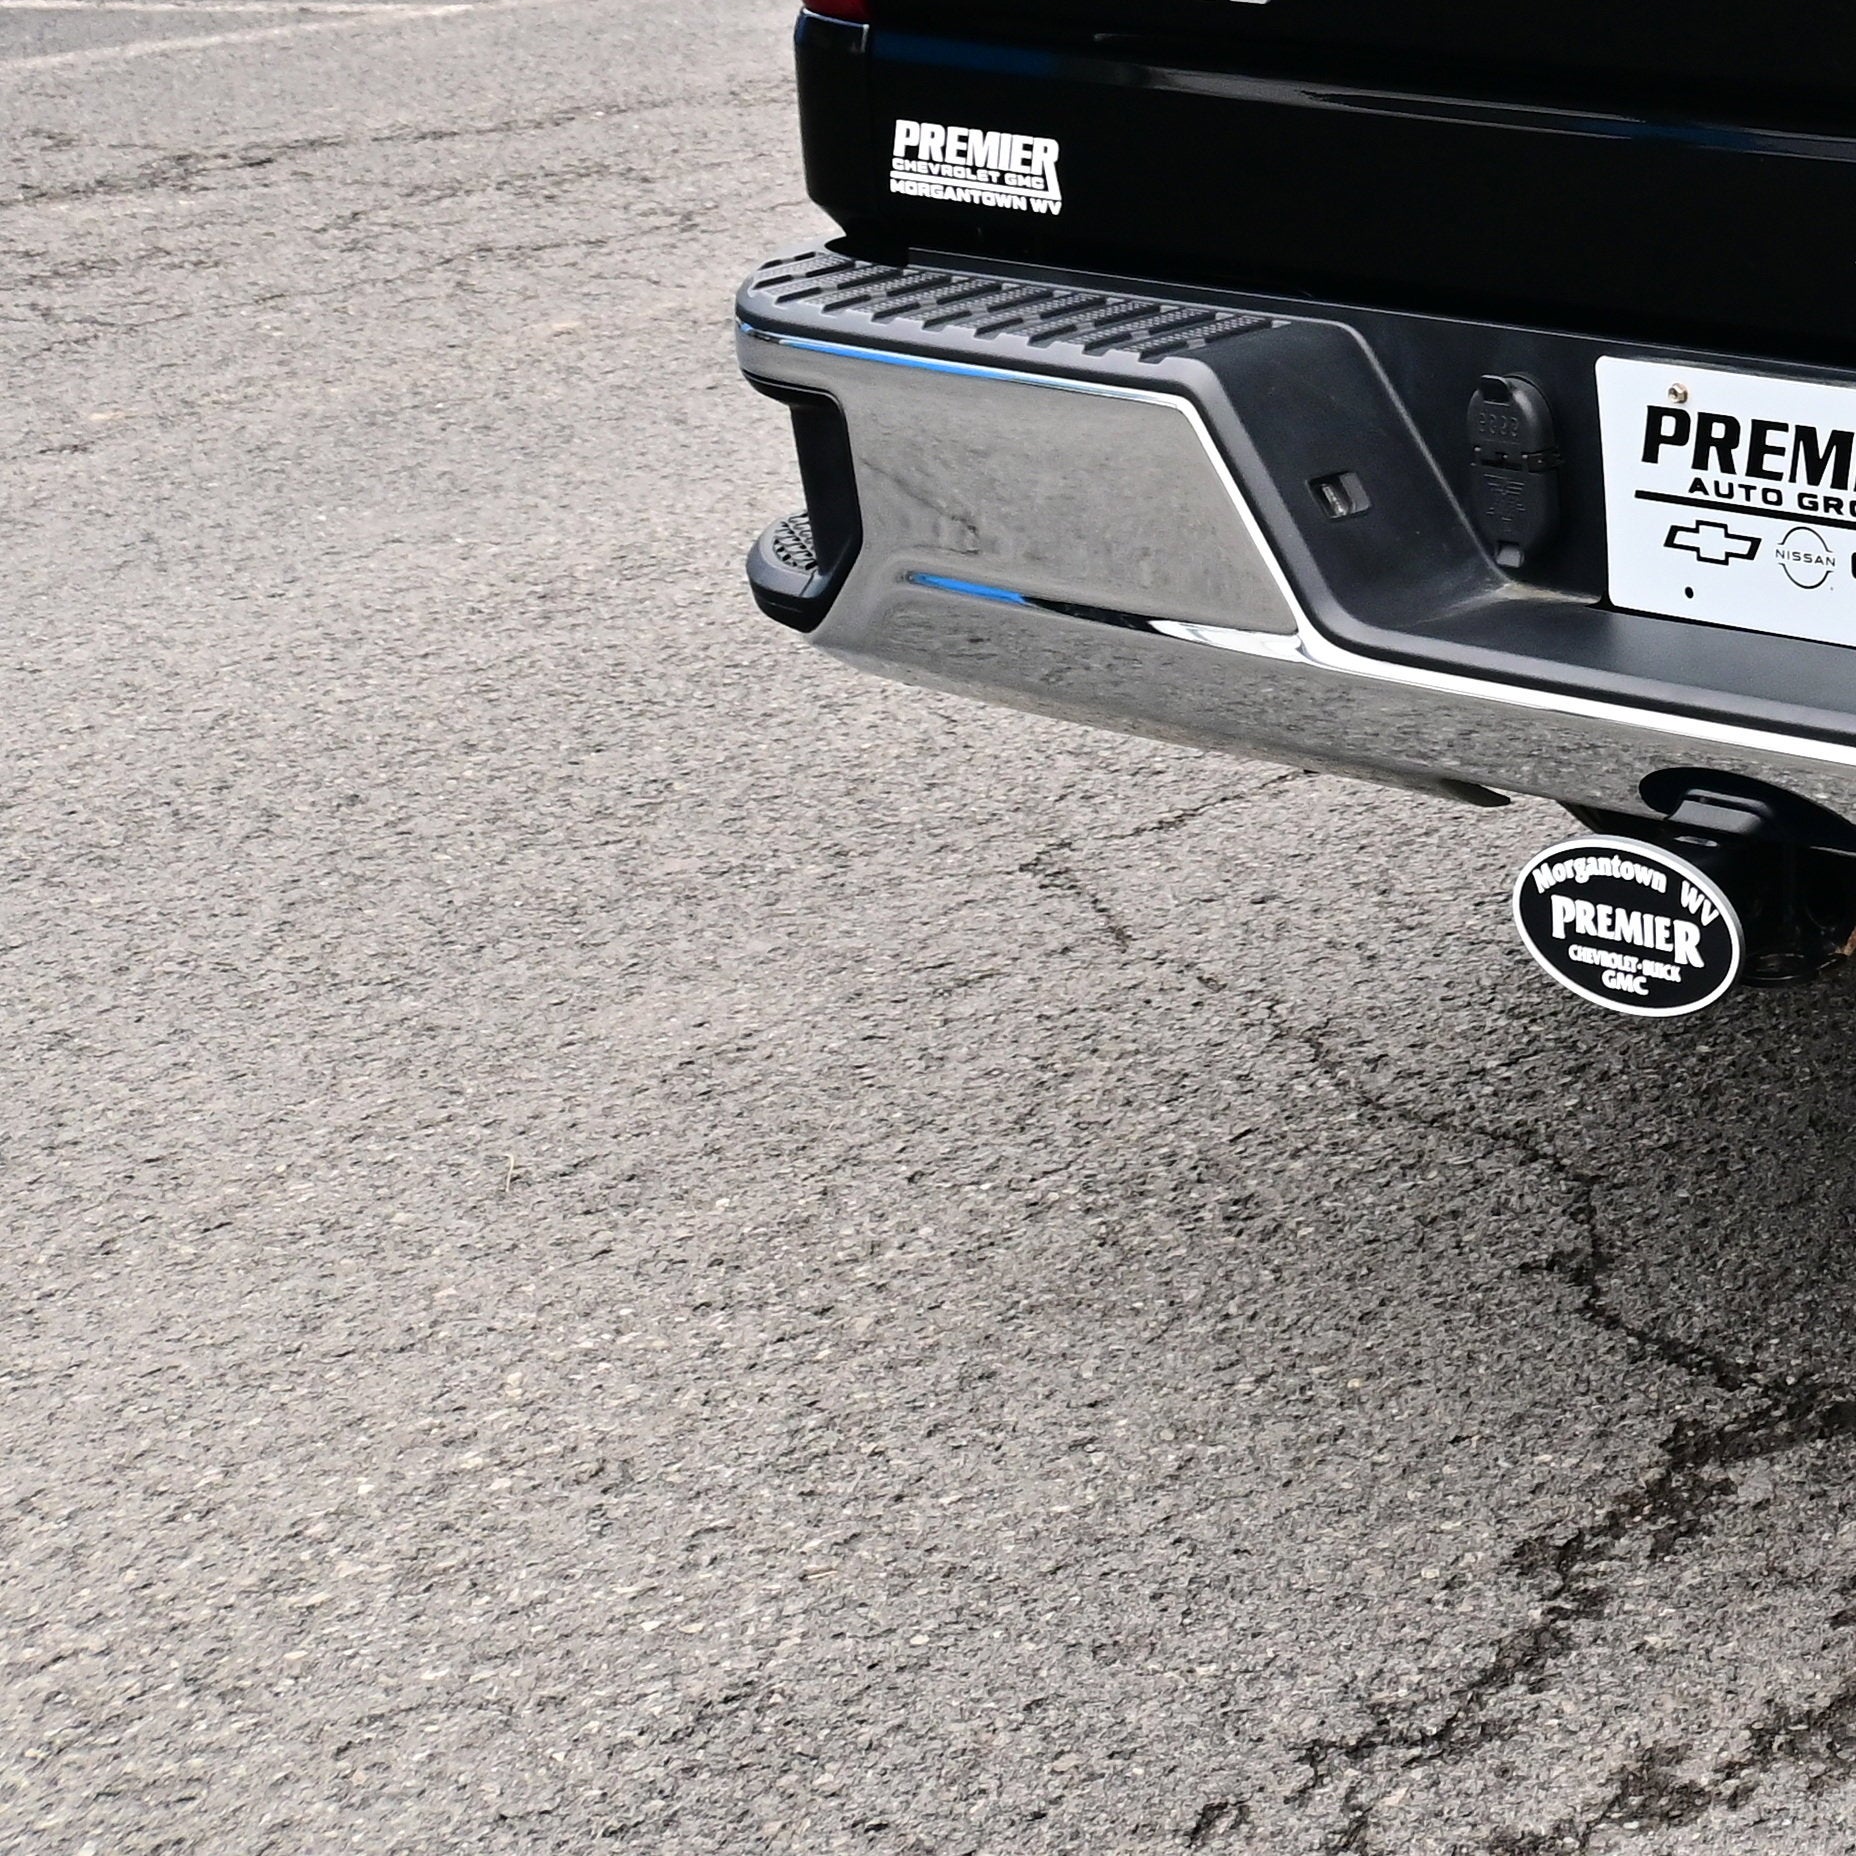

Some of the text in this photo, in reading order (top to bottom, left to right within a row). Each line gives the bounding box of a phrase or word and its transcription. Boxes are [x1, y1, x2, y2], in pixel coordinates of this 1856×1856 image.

[893, 119, 1061, 181] PREMIER
[892, 157, 1045, 190] CHEVROLET GMC
[890, 178, 1062, 216] MORGANTOWN WV
[1688, 476, 1783, 507] AUTO
[1775, 547, 1836, 568] NISSAN
[1532, 854, 1720, 927] Morgantown WV
[1551, 894, 1705, 969] PREMIER
[1601, 969, 1649, 996] GMC
